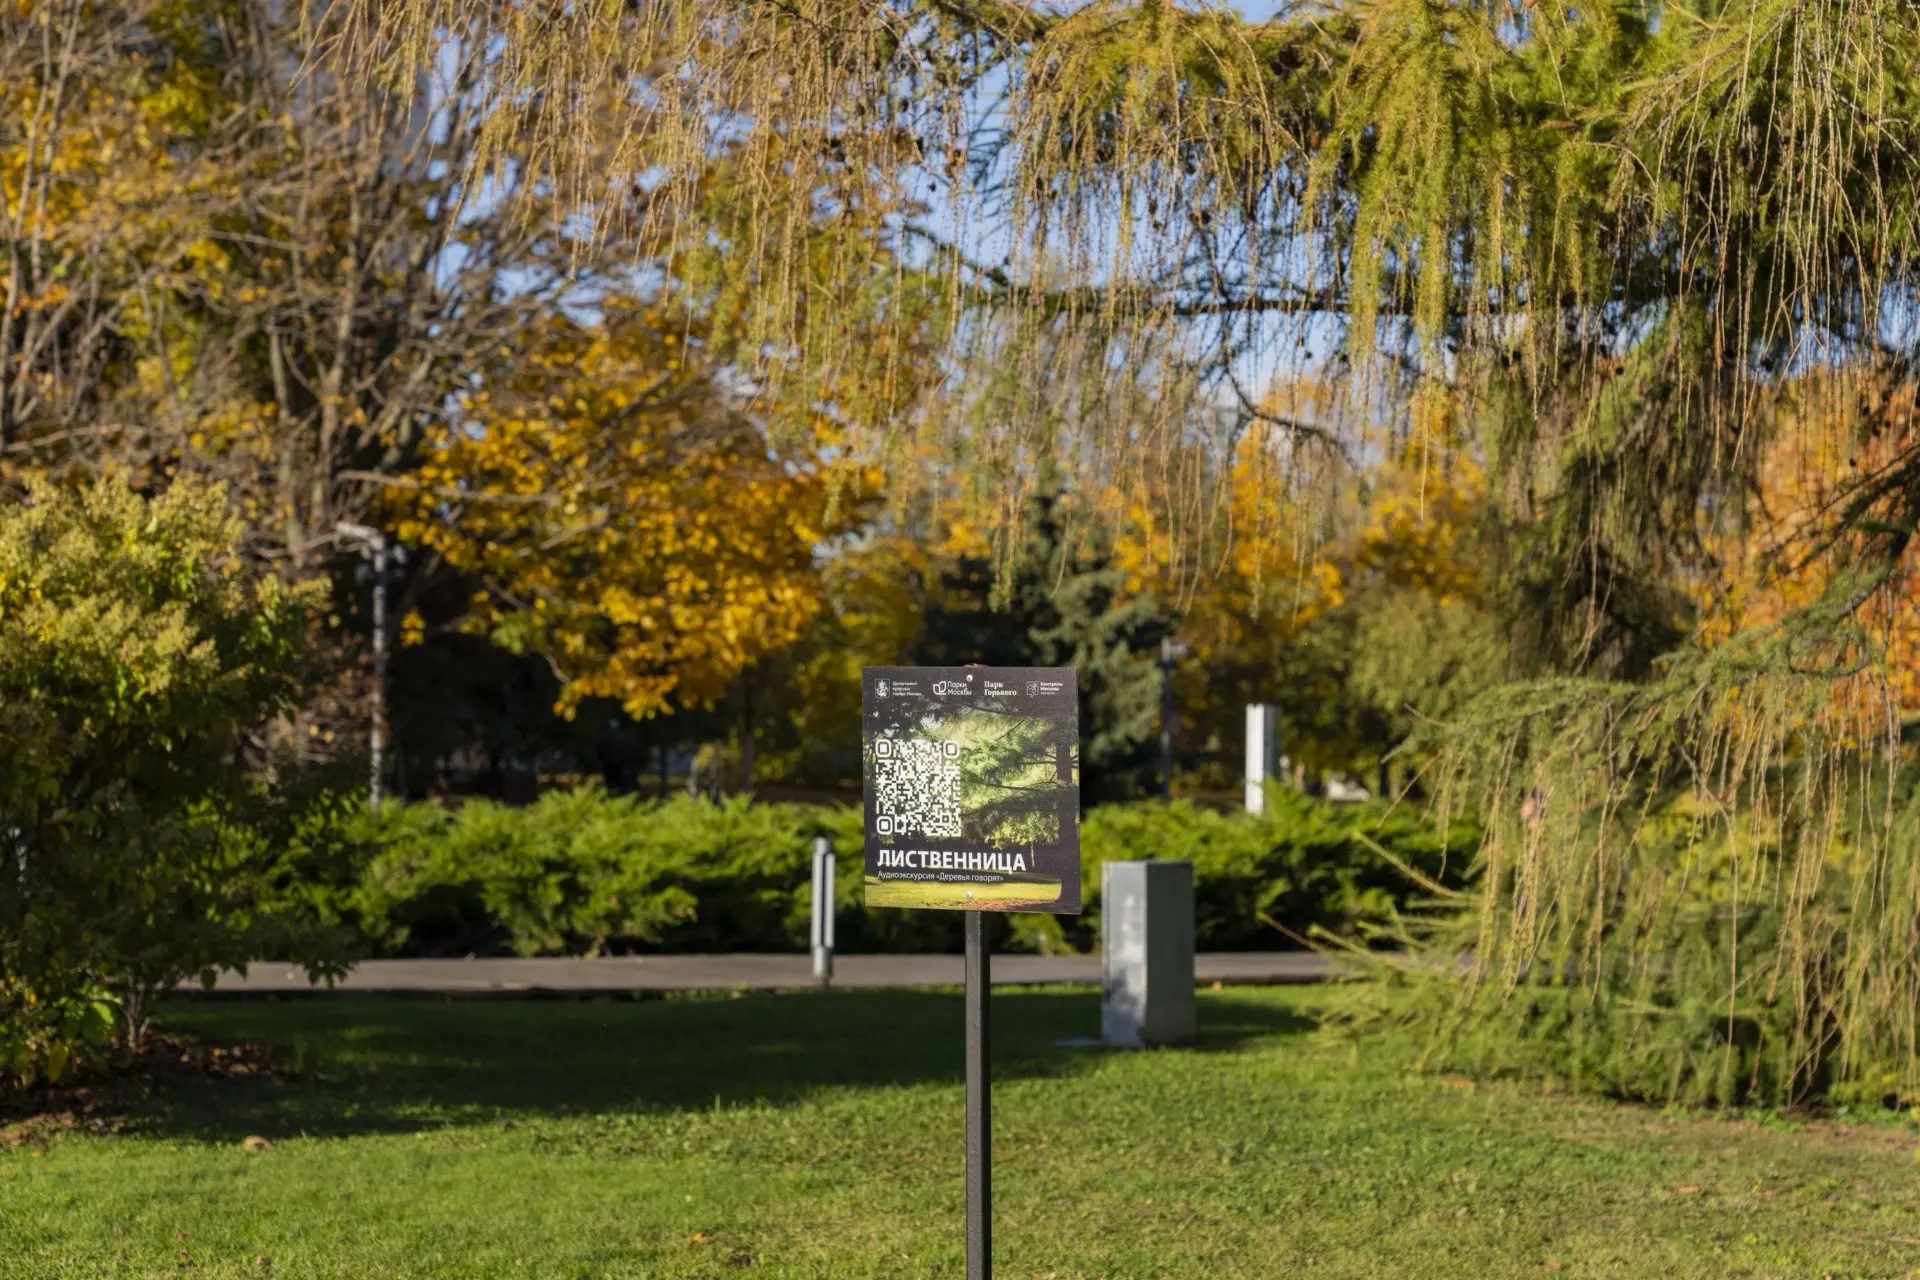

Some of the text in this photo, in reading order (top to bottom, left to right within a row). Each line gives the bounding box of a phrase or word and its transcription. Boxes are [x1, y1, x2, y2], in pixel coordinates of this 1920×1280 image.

[947, 681, 967, 690] Парки
[984, 681, 1004, 690] Парк
[947, 688, 973, 696] Москвы
[984, 689, 1018, 698] Горького
[877, 849, 1027, 875] ЛИСТВЕННИЦА
[877, 870, 1004, 883] Аудиоэкскурсия «Деревья говорят»
